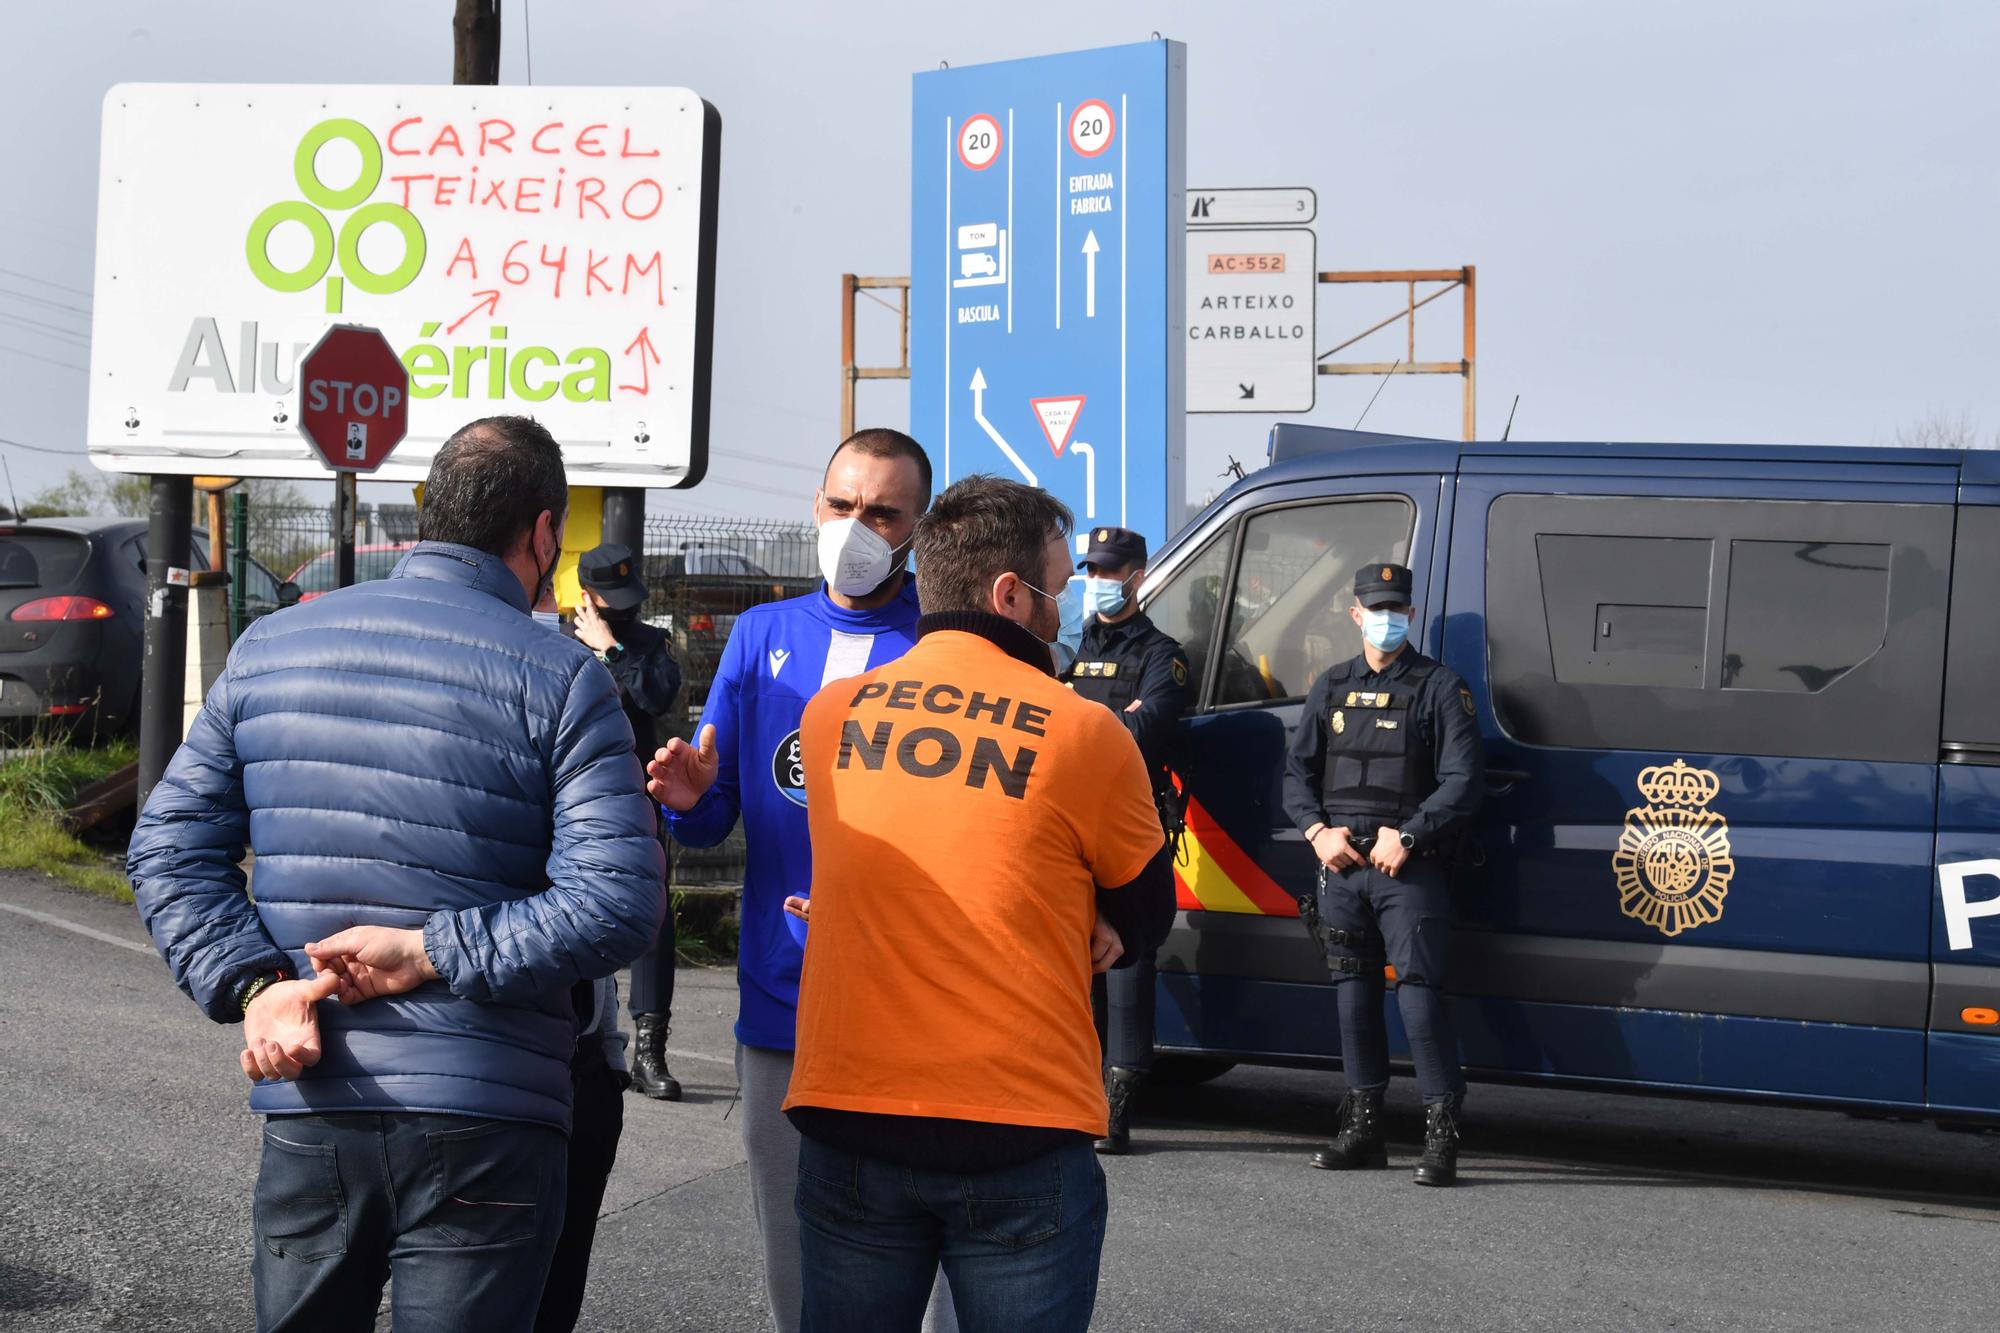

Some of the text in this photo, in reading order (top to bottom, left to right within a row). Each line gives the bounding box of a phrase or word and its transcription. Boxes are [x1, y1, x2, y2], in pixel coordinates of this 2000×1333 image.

[1079, 118, 1103, 137] 20
[387, 117, 661, 159] CARCEL
[968, 132, 991, 151] 20
[1069, 173, 1114, 194] ENTRADA
[1071, 196, 1112, 215] FABRICA
[1296, 200, 1305, 212] 3
[970, 231, 986, 241] TON
[446, 238, 477, 280] A
[1200, 295, 1294, 310] ARTEIXO
[958, 304, 1000, 324] BASCULA
[1189, 324, 1304, 340] CARBALLO
[309, 379, 401, 419] STOP
[849, 680, 1052, 738] PECHE
[837, 720, 1038, 800] NON
[1637, 831, 1709, 870] CUERPO NACIONAL DE
[1654, 890, 1689, 901] POLICIA
